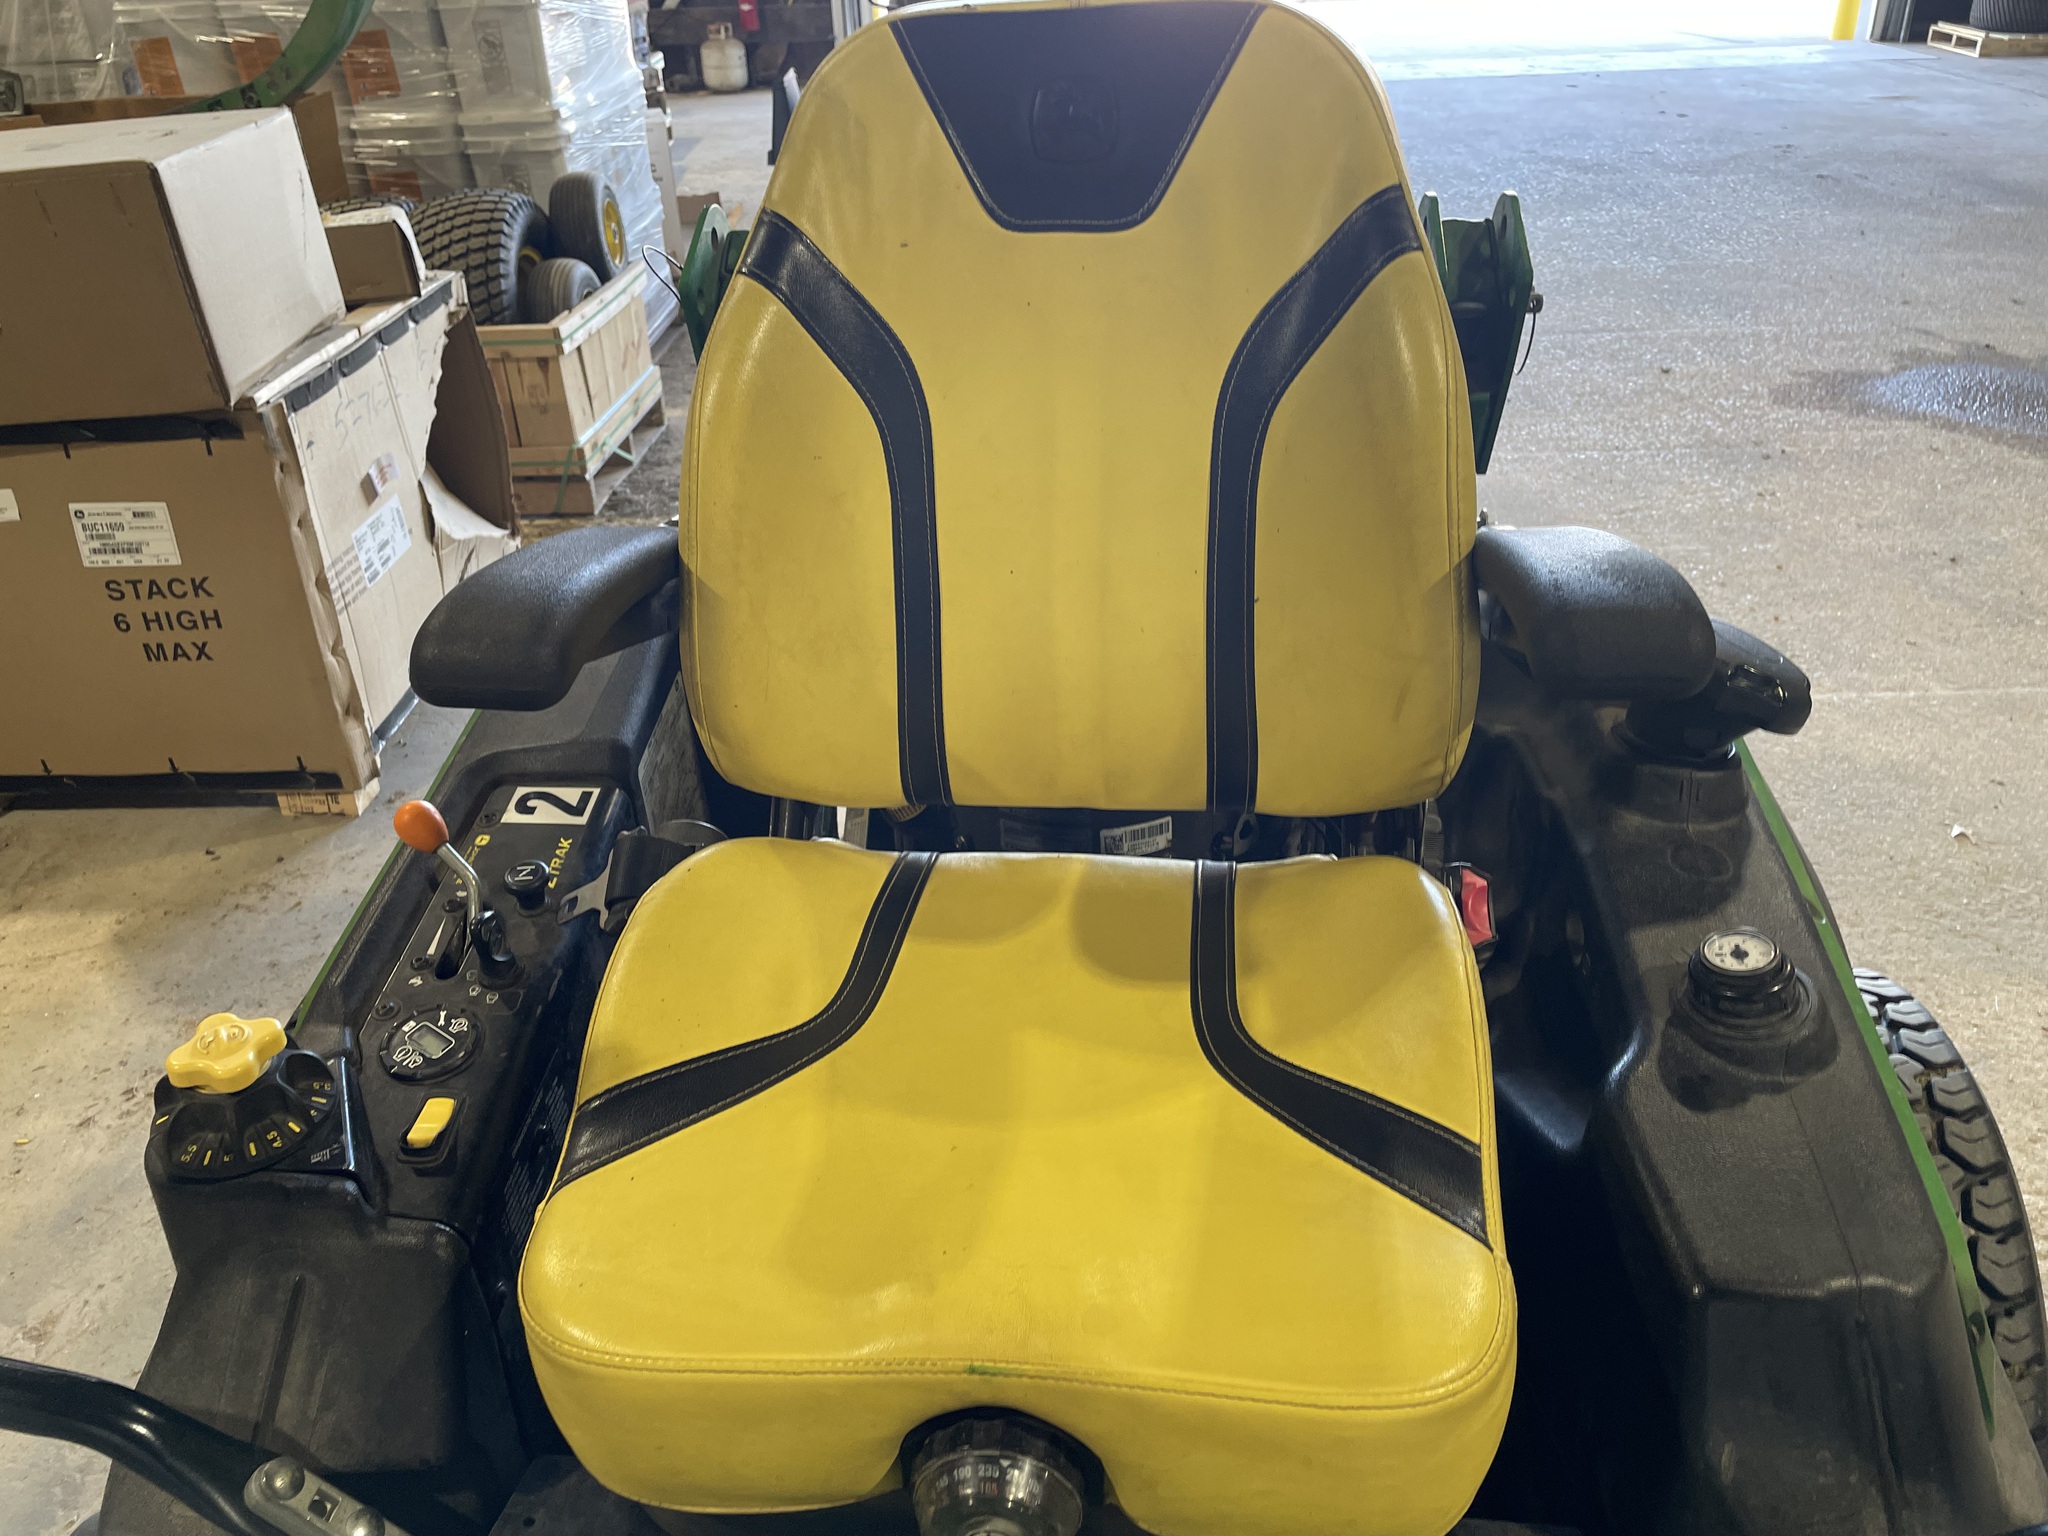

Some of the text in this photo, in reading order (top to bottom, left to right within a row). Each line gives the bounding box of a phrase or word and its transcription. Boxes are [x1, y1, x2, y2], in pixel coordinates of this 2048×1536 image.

[104, 576, 215, 601] STACK
[113, 608, 223, 633] 6 HIGH
[142, 640, 214, 662] MAX
[513, 790, 594, 818] 2
[266, 1130, 283, 1148] 4.5
[180, 1144, 198, 1163] 5.5
[952, 1465, 972, 1482] 190
